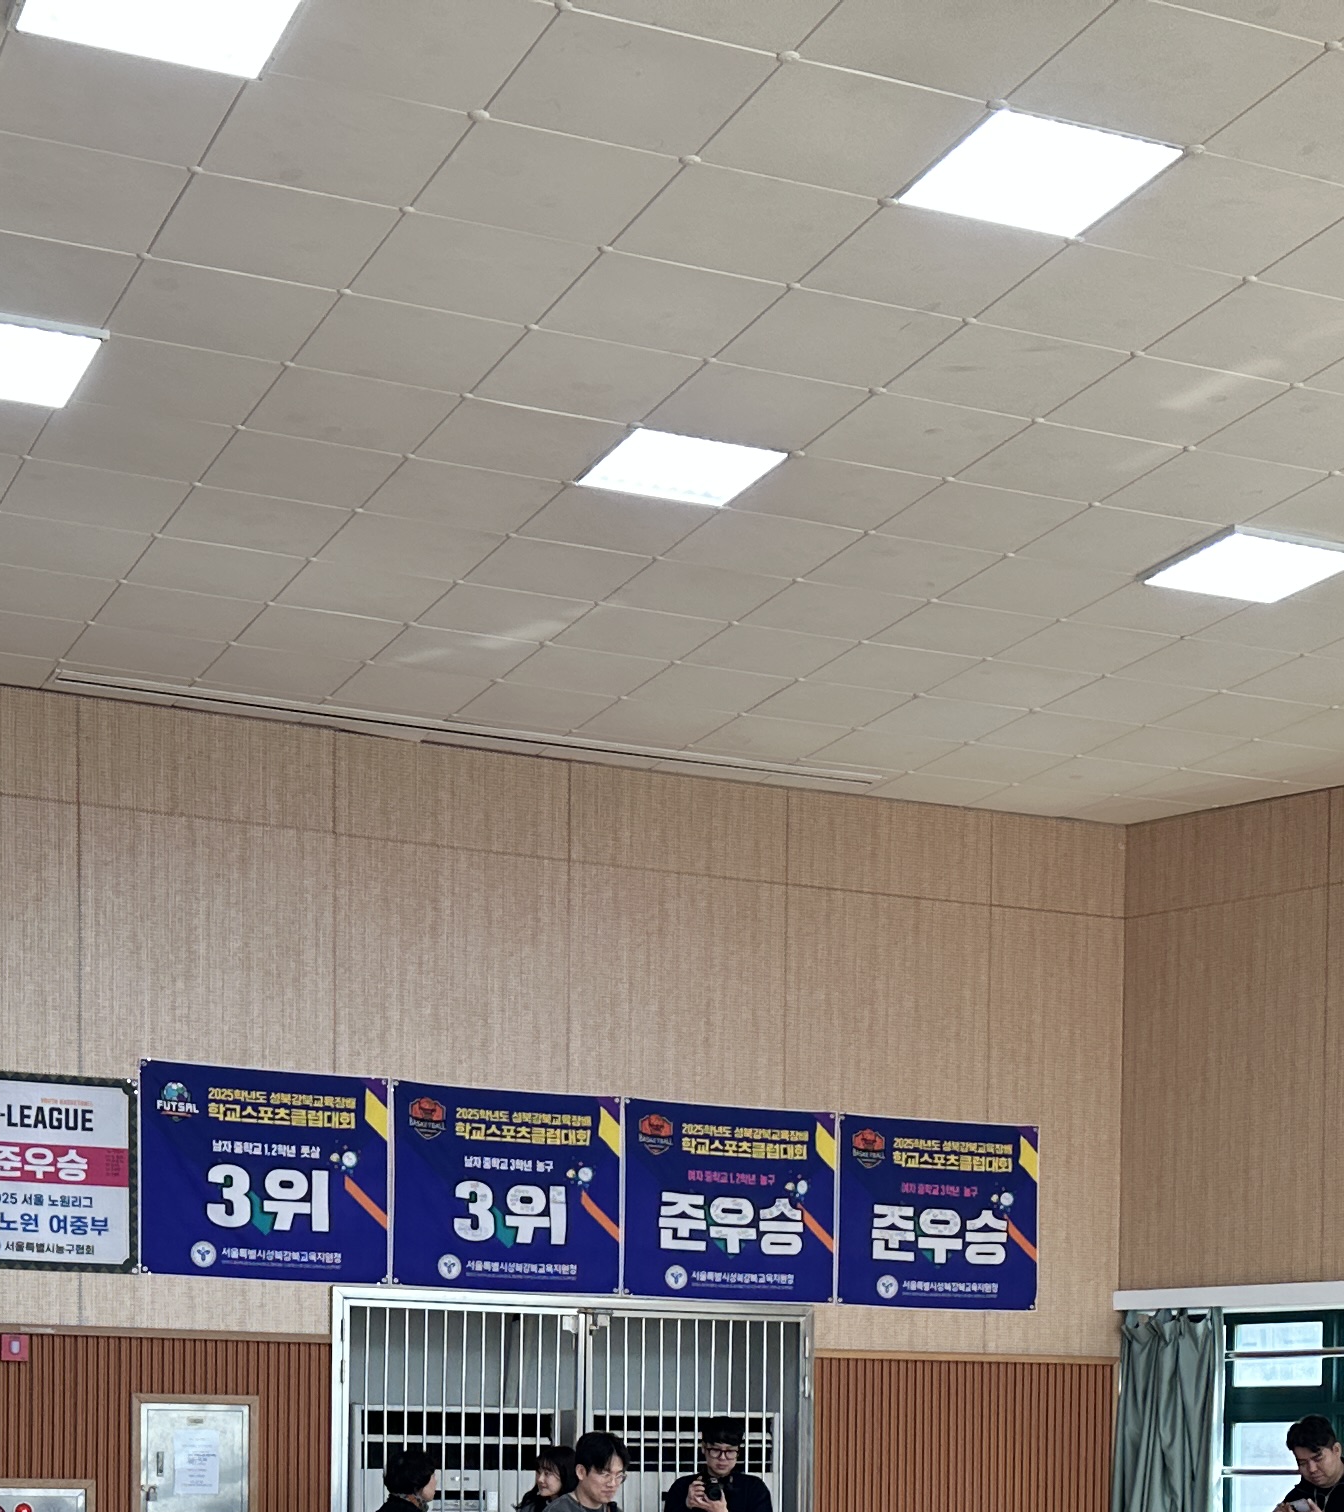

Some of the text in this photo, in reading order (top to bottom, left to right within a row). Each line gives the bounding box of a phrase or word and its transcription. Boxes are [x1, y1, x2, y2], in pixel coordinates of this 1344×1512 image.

[207, 1086, 268, 1104] 2025학년도
[156, 1099, 200, 1114] FUTSAL
[207, 1102, 356, 1130] 학교스포츠클럽대회
[456, 1107, 510, 1122] 2025학년도
[455, 1122, 592, 1147] 학교스포츠클럽대회
[212, 1139, 232, 1153] 남자
[233, 1140, 262, 1156] 중학교
[681, 1137, 808, 1160] 학교스포츠클럽대회
[892, 1151, 1013, 1173] 학교스포츠클럽대회
[21, 1193, 45, 1207] 서울
[48, 1194, 94, 1209] 노원리그
[206, 1163, 330, 1232] 3위
[453, 1180, 567, 1245] 3위
[658, 1191, 804, 1256] 준우승
[49, 1214, 110, 1236] 여중부
[871, 1204, 1008, 1265] 준우승
